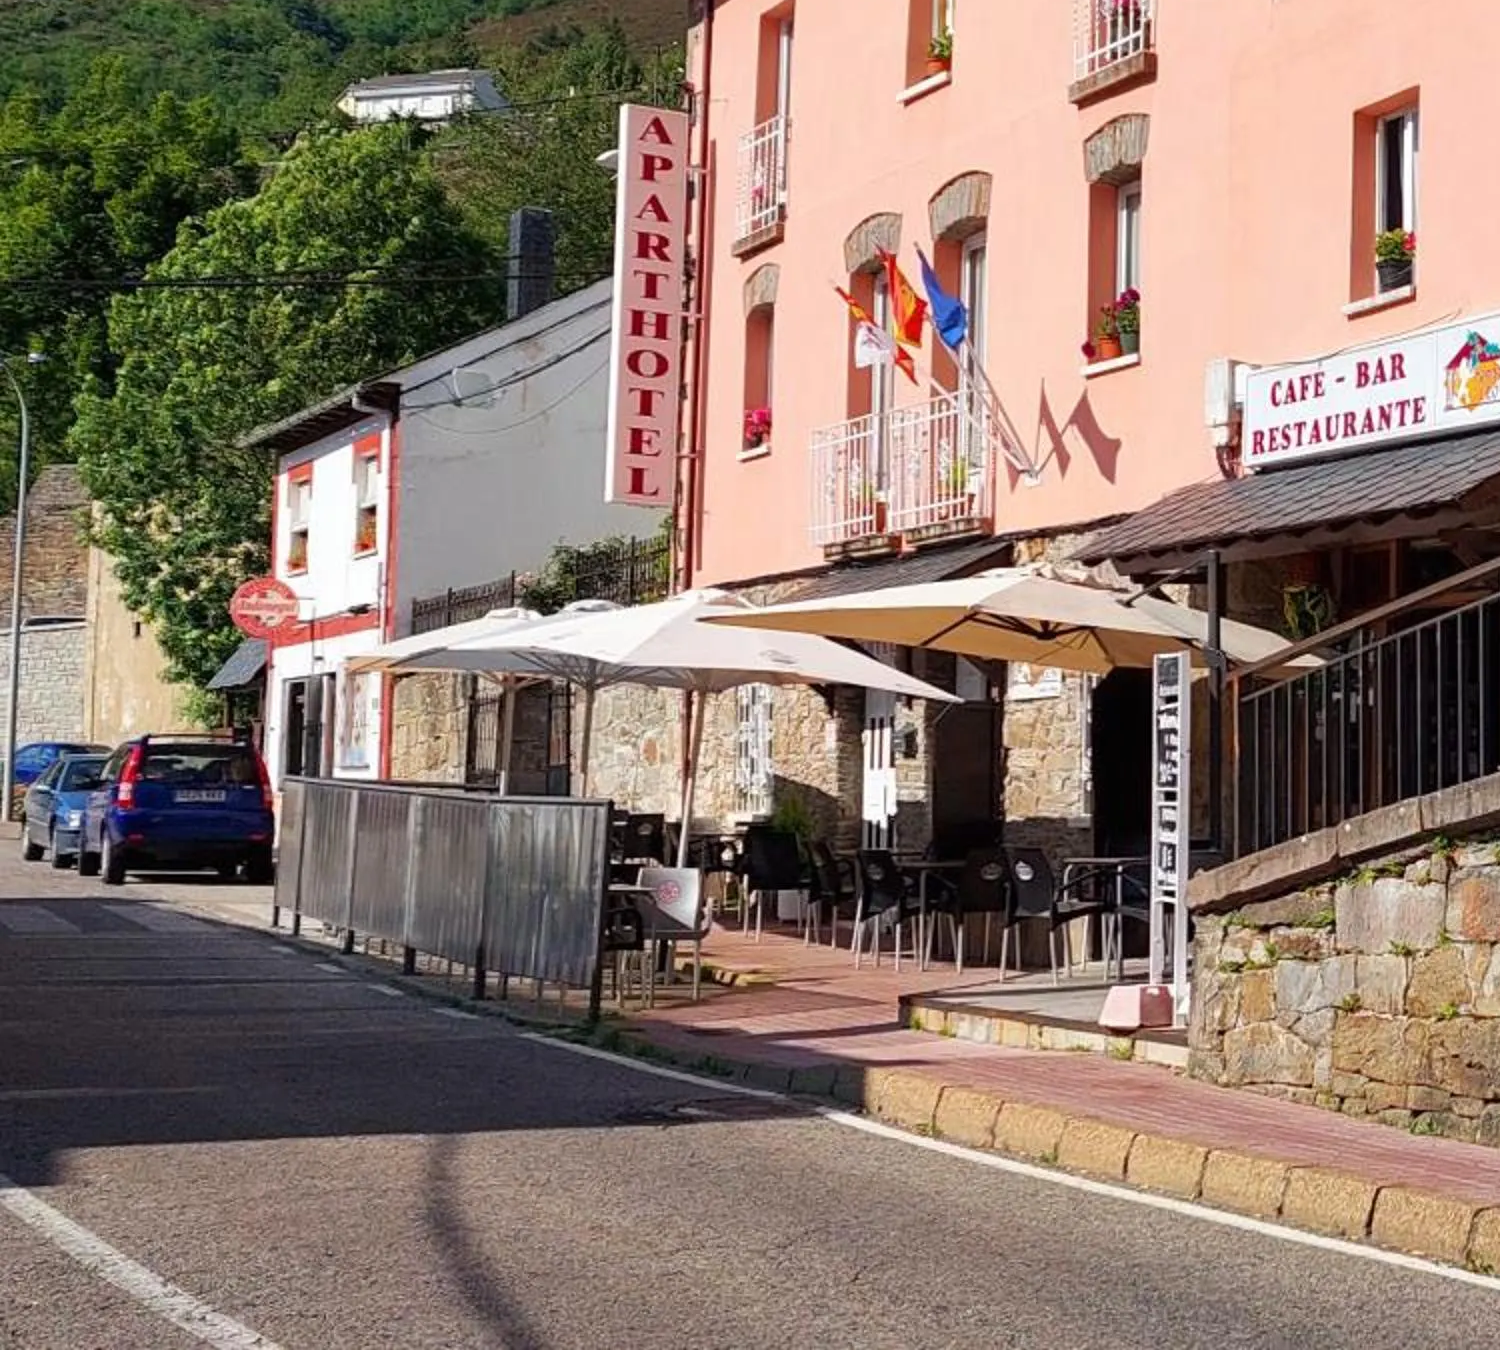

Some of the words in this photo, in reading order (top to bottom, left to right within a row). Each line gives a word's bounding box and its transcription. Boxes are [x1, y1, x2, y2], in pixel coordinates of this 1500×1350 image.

[626, 116, 673, 497] APARTHOTEL
[1271, 371, 1325, 407] CAFE
[1356, 353, 1406, 388] BAR
[1252, 397, 1426, 455] RESTAURANTE
